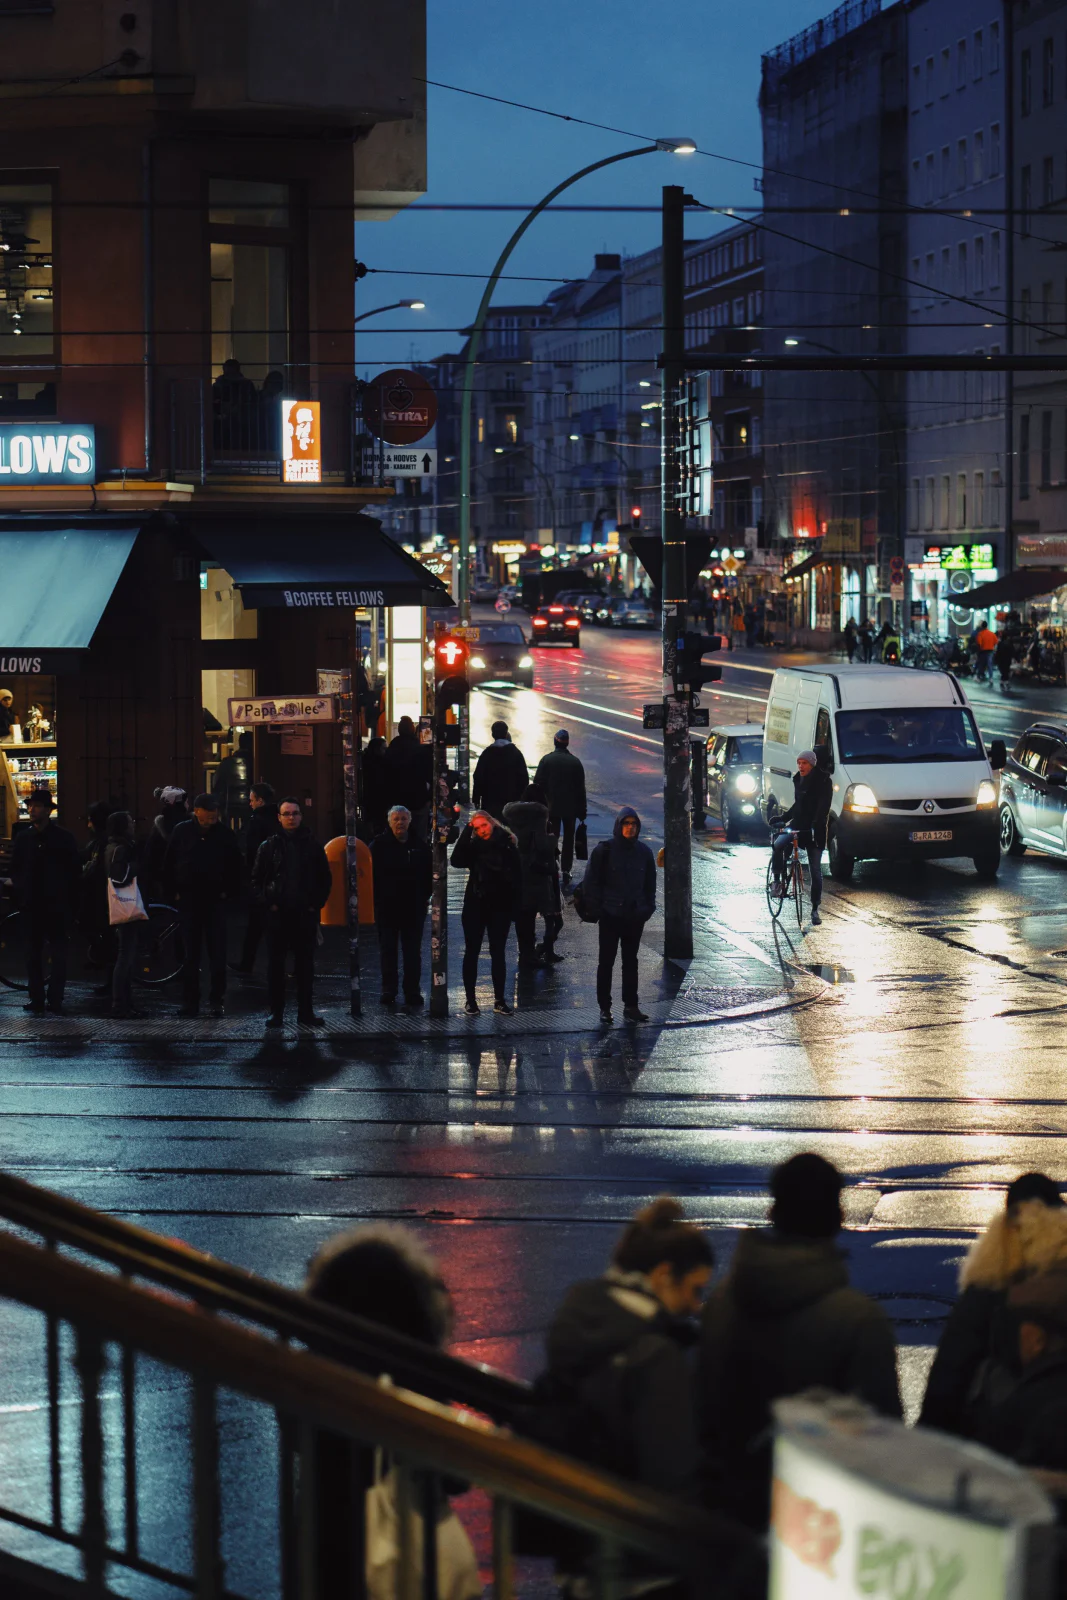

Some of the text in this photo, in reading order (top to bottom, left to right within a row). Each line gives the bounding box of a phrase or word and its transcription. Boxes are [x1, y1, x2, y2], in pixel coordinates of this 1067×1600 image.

[286, 459, 319, 473] COFFEE
[293, 590, 385, 607] COFFEE FELLOWS
[0, 657, 42, 673] LOWS
